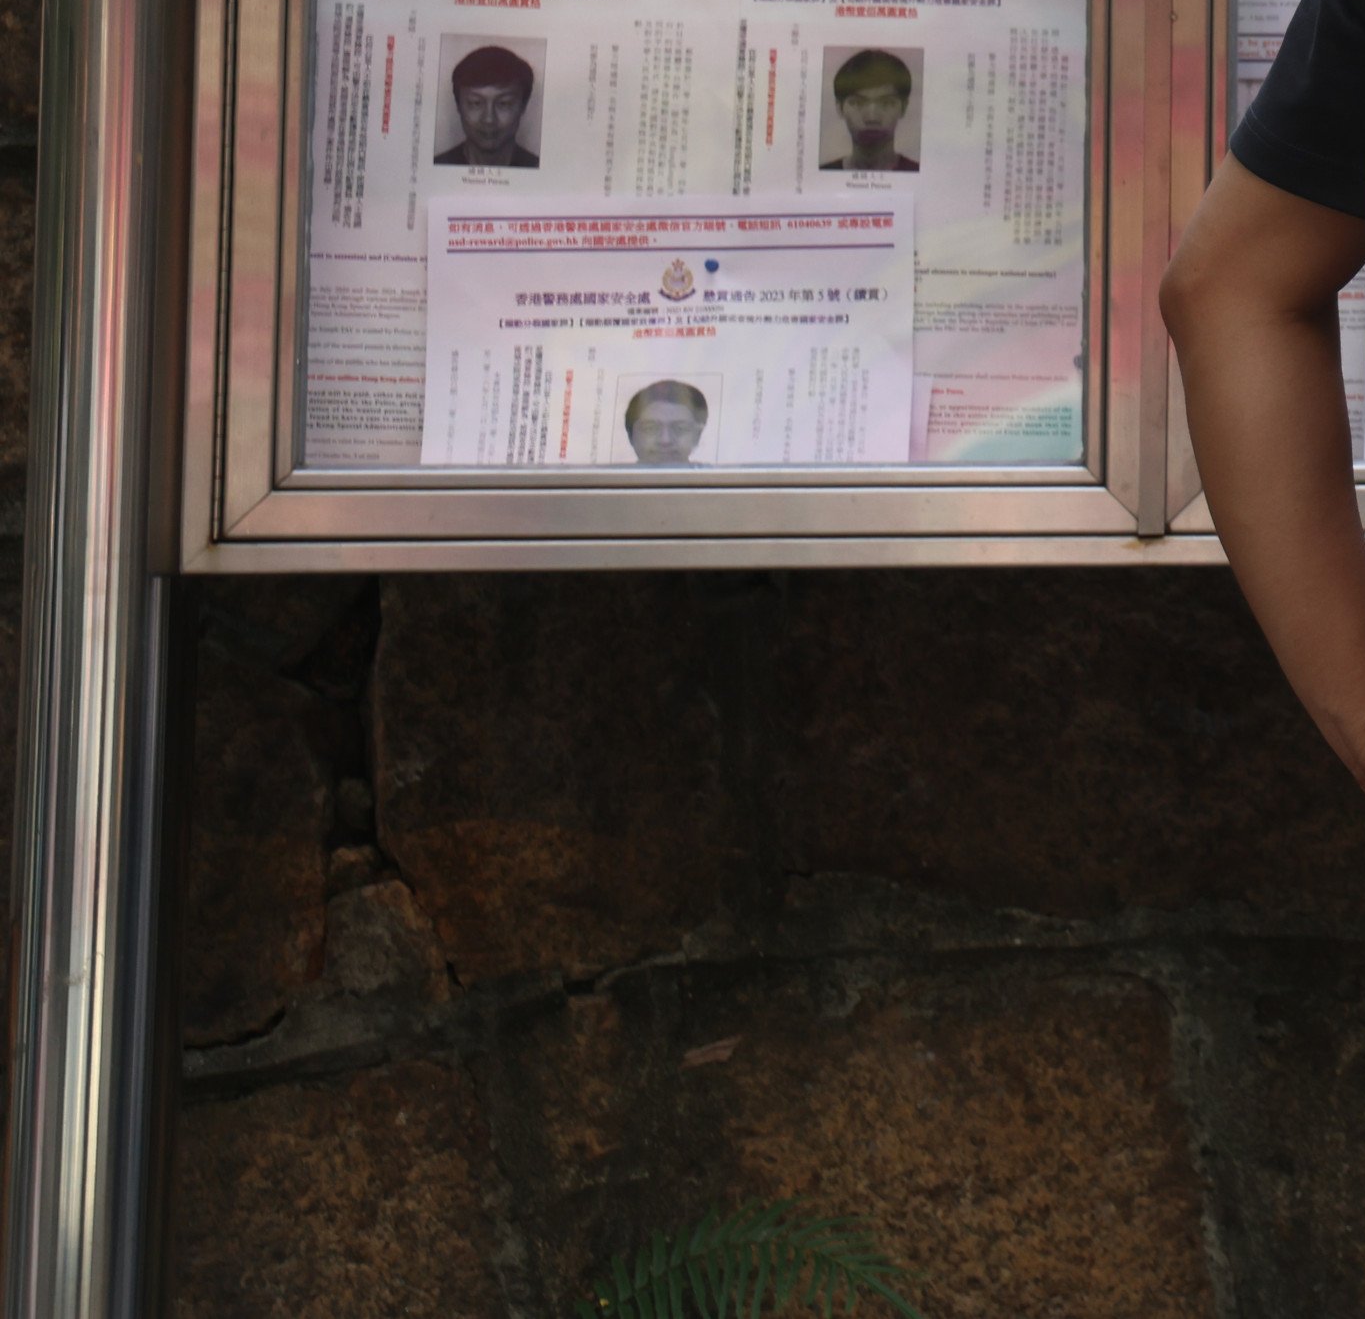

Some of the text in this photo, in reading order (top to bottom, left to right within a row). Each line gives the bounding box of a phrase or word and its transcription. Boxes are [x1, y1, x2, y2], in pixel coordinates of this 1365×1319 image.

[515, 292, 651, 307] 香港警務處國家安全處
[760, 290, 785, 302] 2023
